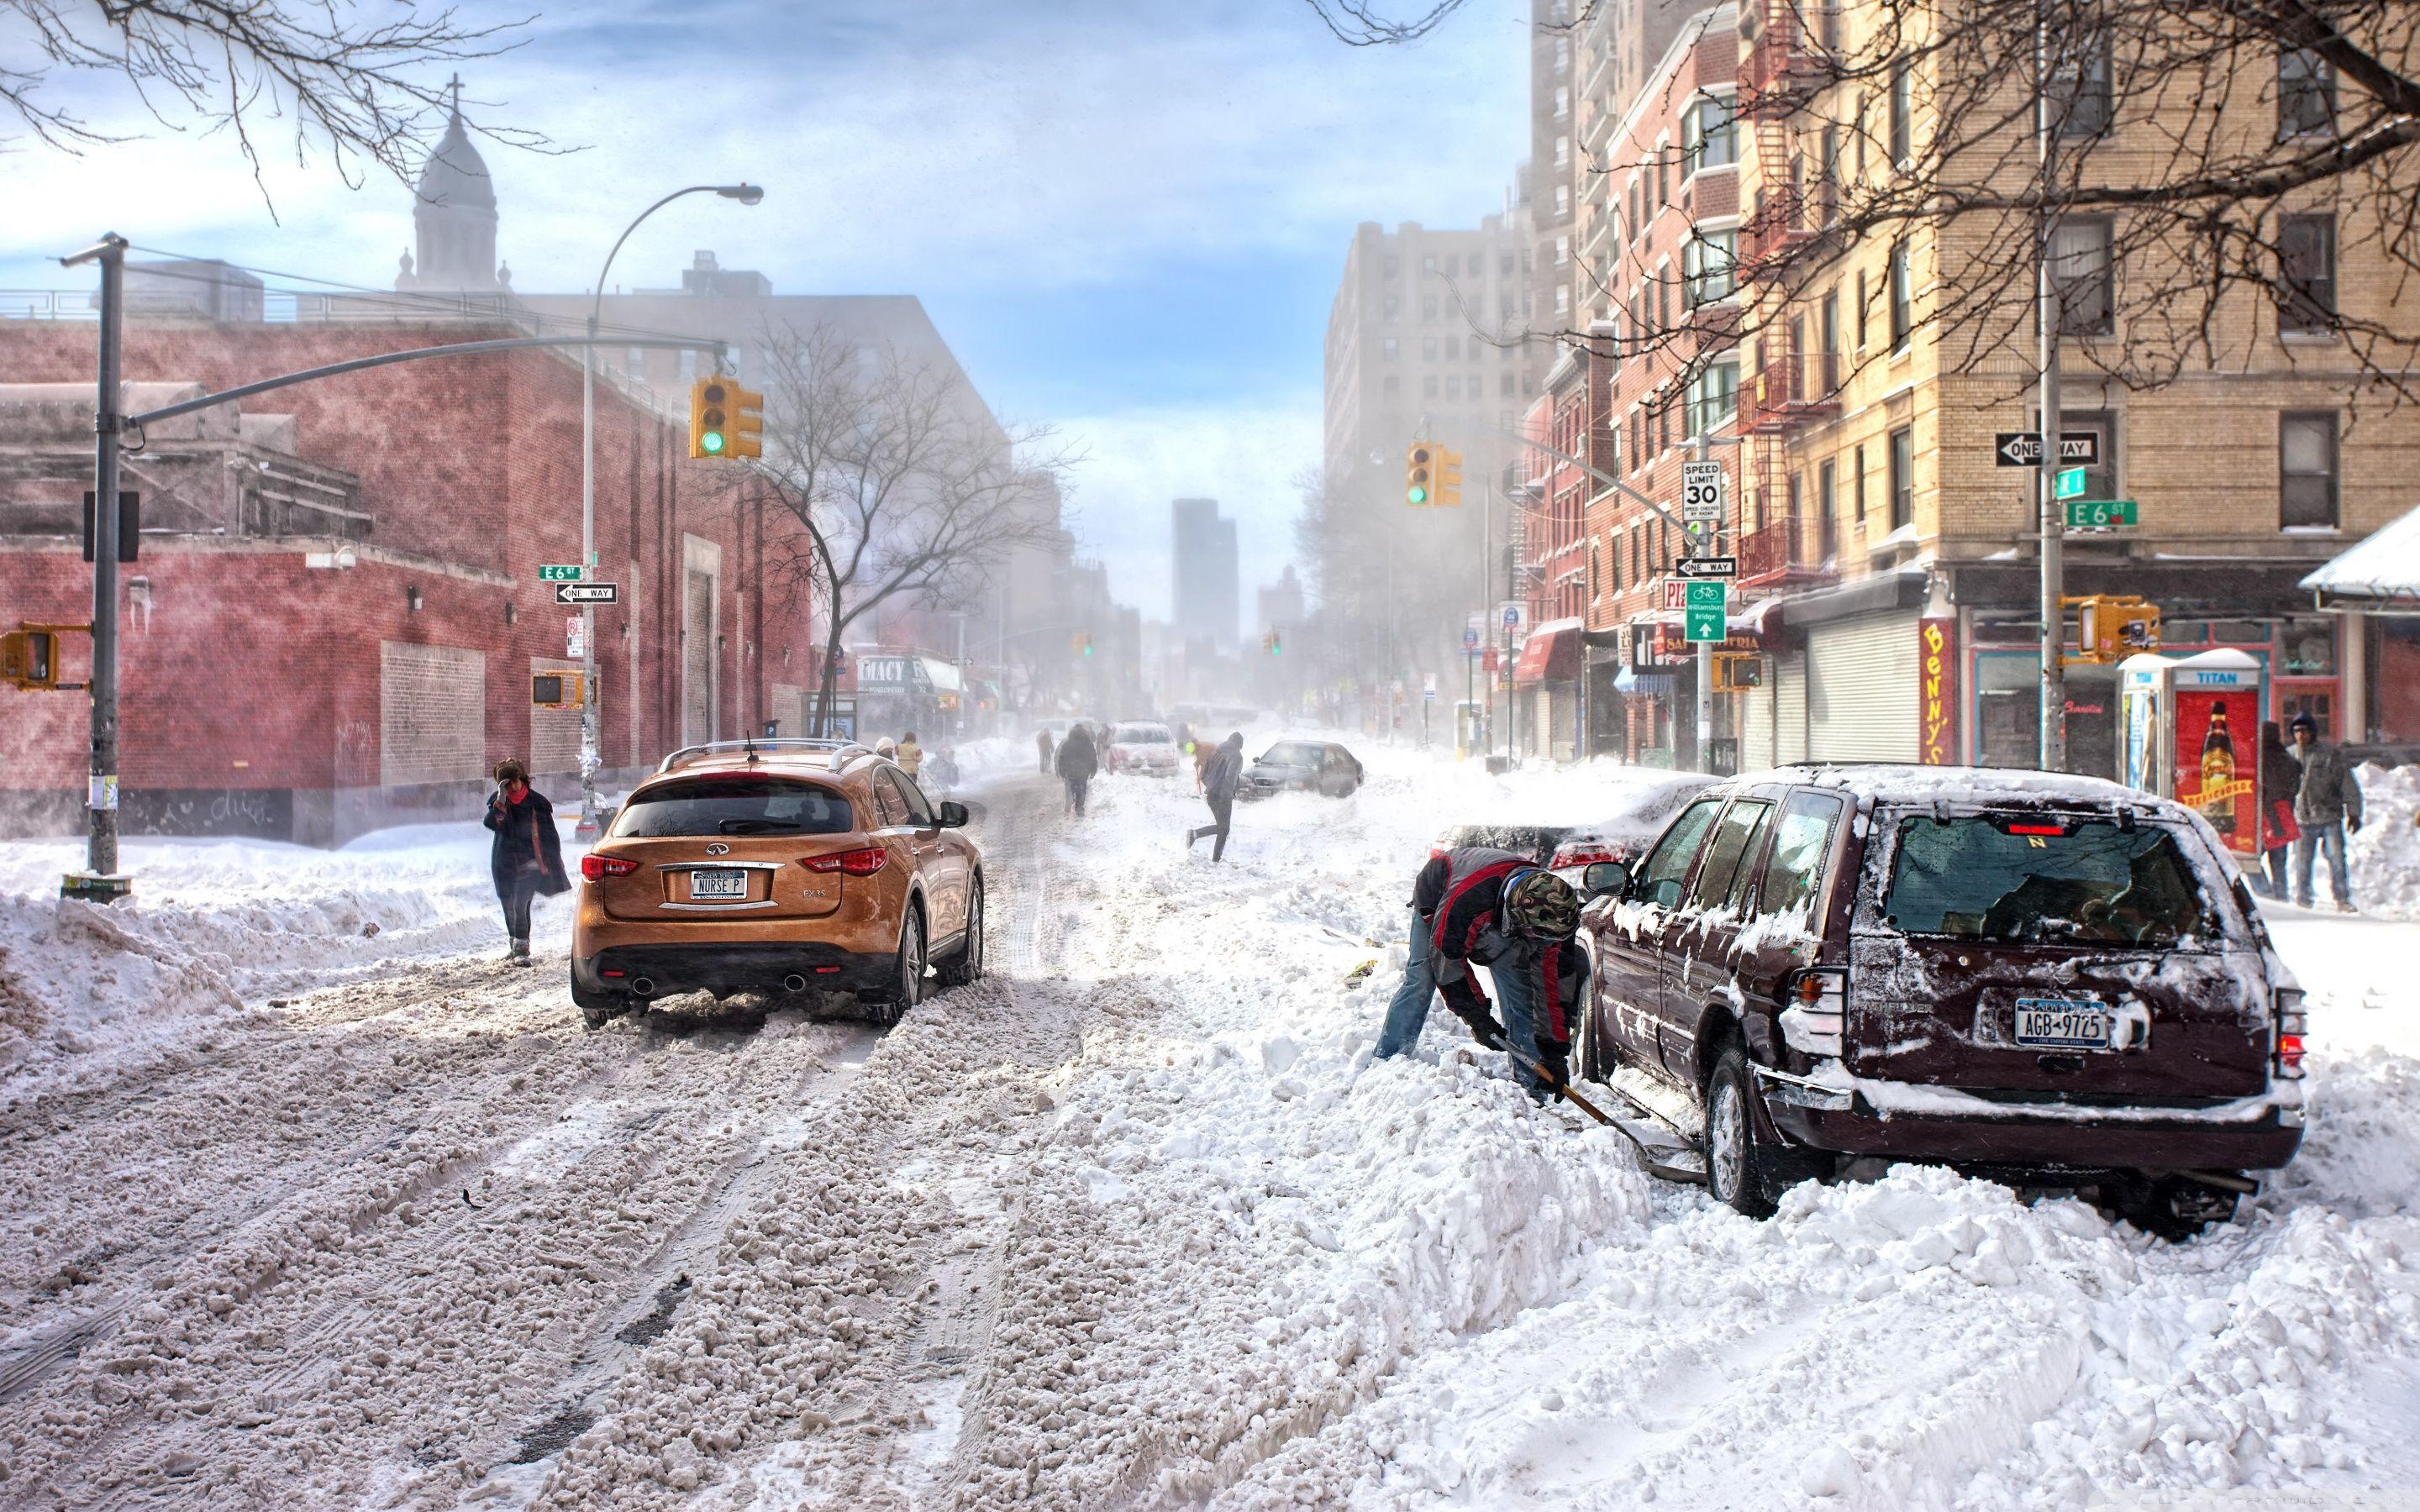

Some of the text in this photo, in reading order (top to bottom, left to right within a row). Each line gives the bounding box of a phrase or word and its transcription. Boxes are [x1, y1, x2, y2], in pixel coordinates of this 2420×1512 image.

[2011, 442, 2040, 456] ONE
[1686, 465, 1718, 474] SPEED
[1689, 475, 1714, 484] LIMIT
[1686, 486, 1717, 504] 30
[2075, 503, 2125, 523] E 6 ST
[545, 568, 553, 579] E
[556, 568, 564, 579] 6
[565, 589, 608, 597] ONE WAY
[2197, 672, 2238, 684] TITAN
[768, 727, 774, 735] P
[698, 879, 739, 892] NURSE P
[2025, 1013, 2100, 1038] AGB 9725
